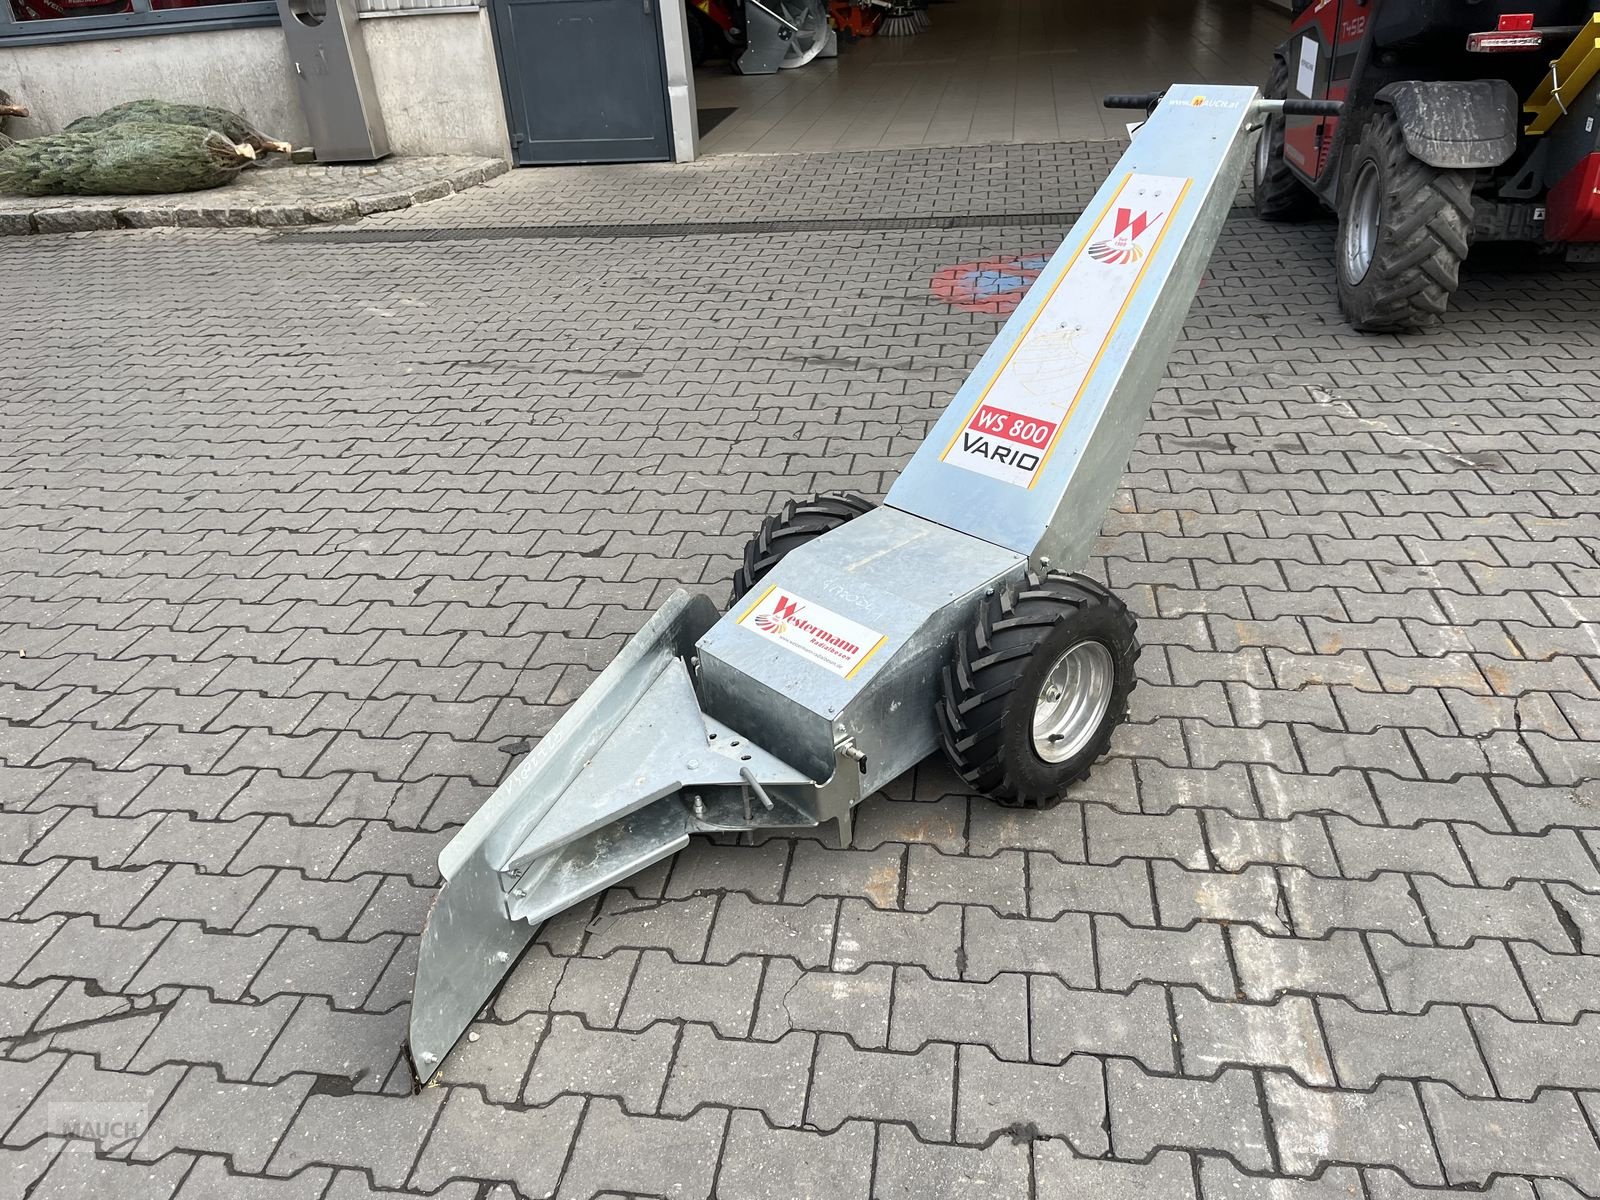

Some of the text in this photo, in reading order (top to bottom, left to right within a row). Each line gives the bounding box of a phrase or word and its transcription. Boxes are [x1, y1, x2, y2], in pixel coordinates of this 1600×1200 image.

[1342, 16, 1365, 38] T4512
[977, 409, 1049, 444] WS 800
[963, 432, 1040, 472] VARIO
[772, 595, 860, 655] Westermann
[810, 637, 852, 661] Radialbesen
